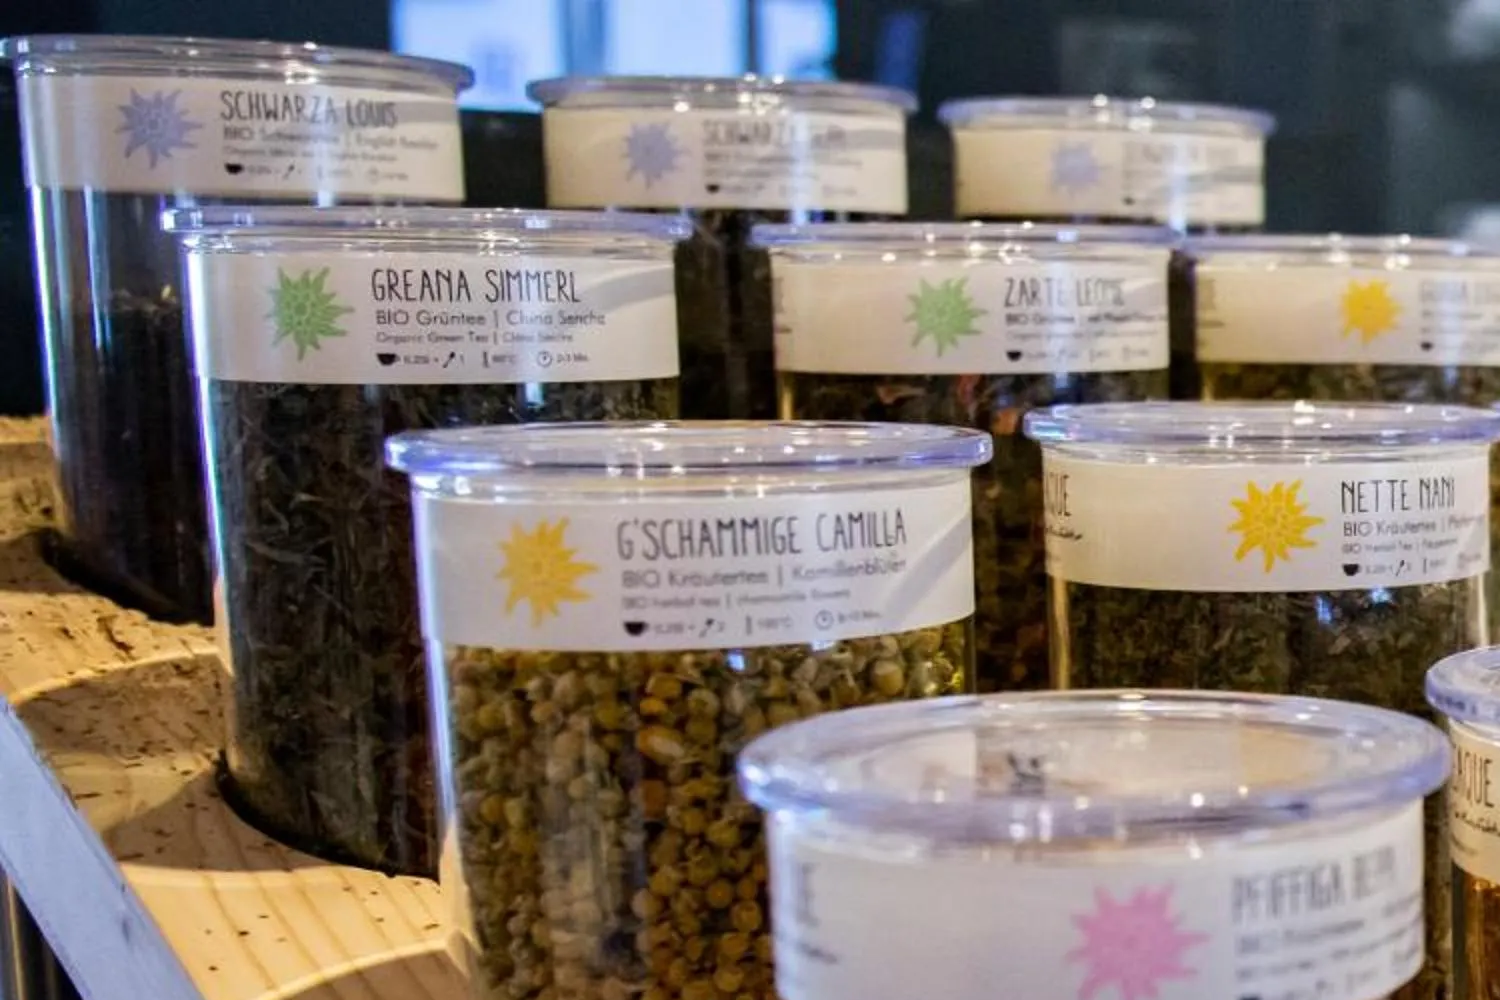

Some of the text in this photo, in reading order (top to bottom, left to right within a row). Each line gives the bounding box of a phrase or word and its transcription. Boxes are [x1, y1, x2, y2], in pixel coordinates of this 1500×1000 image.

[220, 90, 398, 129] SCHWARZA LOUIS
[371, 268, 582, 303] GREANA SIMMERL
[1004, 277, 1066, 307] ZARTE
[375, 310, 410, 326] BIO
[416, 309, 487, 326] Grüntee
[506, 309, 553, 326] China
[1341, 475, 1455, 514] NETTE NANI
[617, 508, 907, 561] G'SCHAMMIGE CAMILLA
[1343, 521, 1373, 537] BIO
[621, 570, 661, 589] BIO
